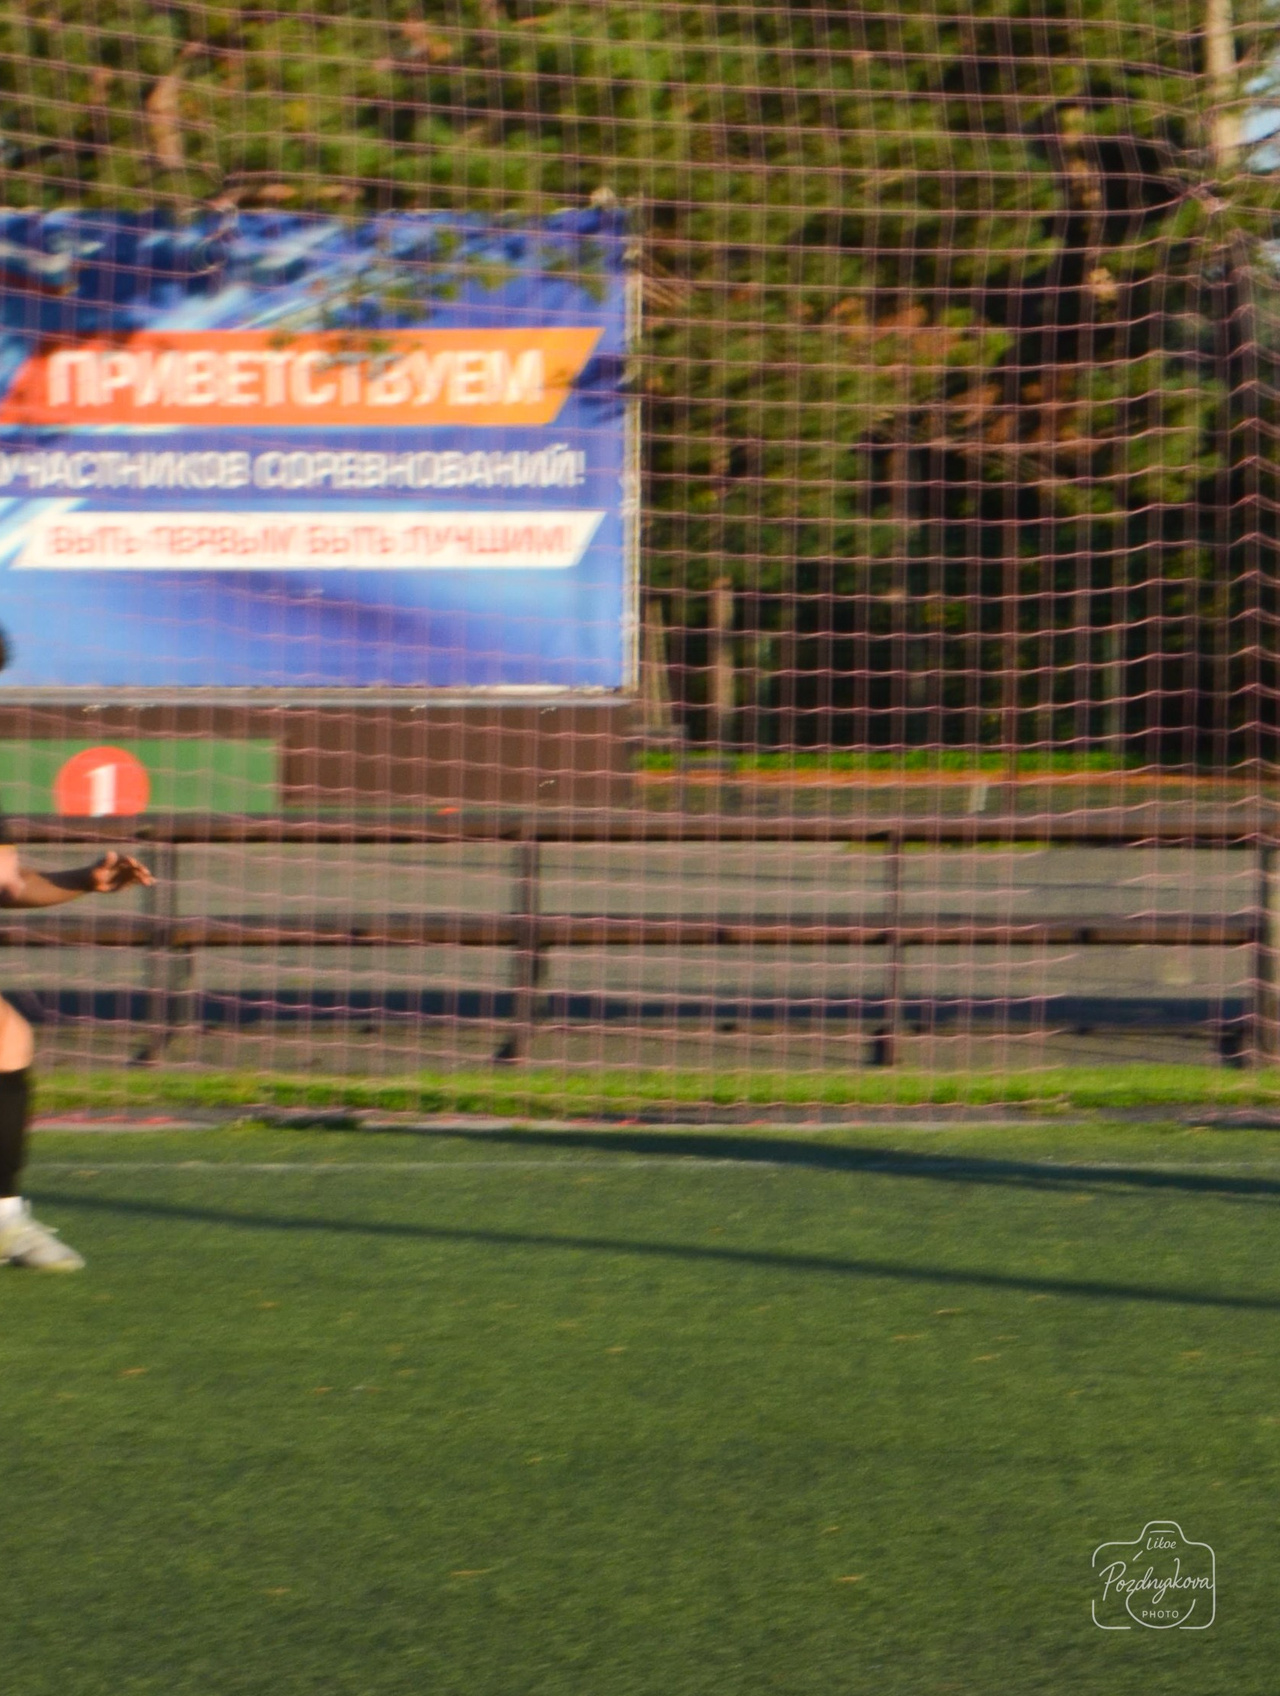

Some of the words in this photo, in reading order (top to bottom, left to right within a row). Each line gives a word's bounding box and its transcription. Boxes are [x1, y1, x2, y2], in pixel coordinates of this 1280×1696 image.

[48, 349, 545, 407] ПРИВЕТСТВУЕМ
[253, 442, 587, 489] СОРЕВНОВАНИЙ!
[48, 524, 142, 555] БЫТЬ
[306, 524, 397, 555] БЫТЬ
[83, 763, 117, 817] 1
